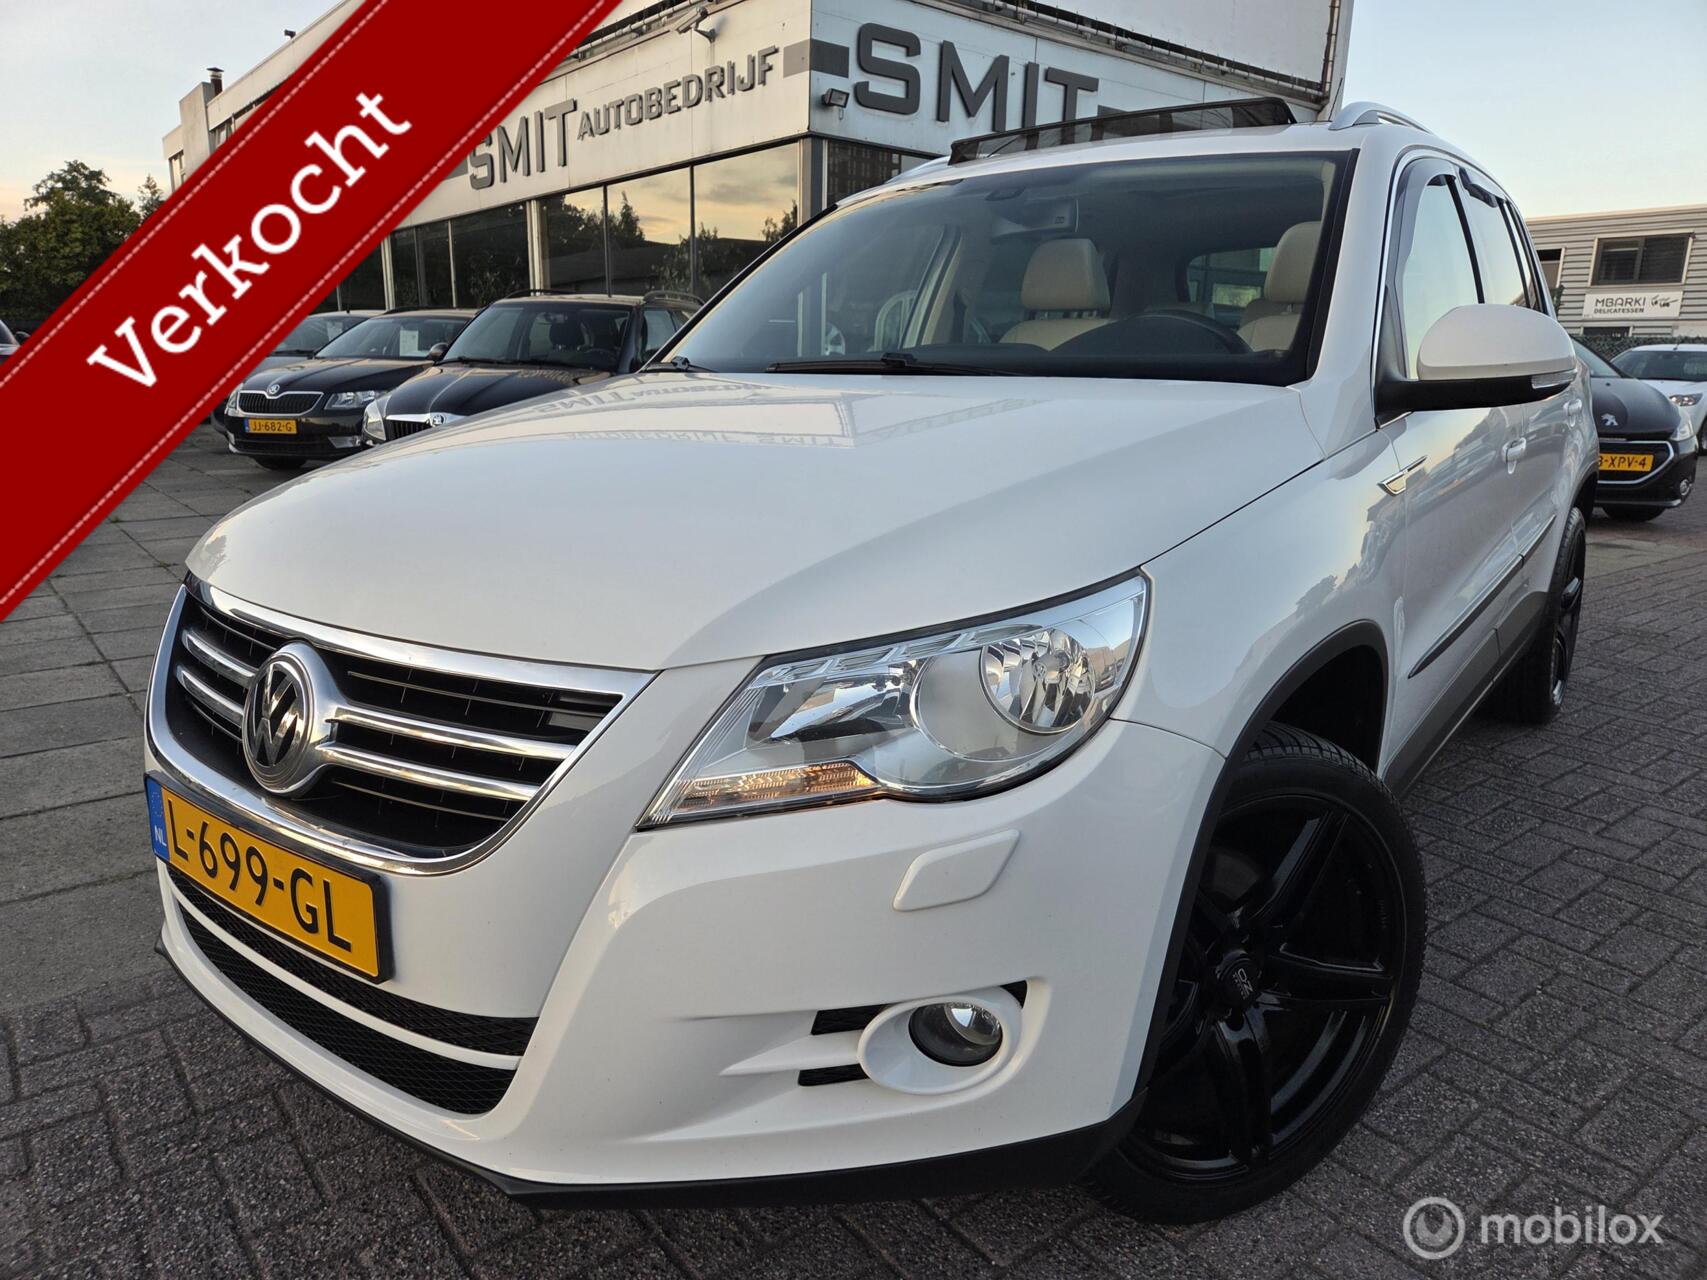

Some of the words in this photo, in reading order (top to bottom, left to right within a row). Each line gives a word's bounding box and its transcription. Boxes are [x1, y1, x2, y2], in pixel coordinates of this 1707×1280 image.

[469, 98, 577, 190] SMIT
[577, 46, 779, 141] AUTOBEDRIJF
[854, 22, 1099, 150] SMIT
[1595, 297, 1646, 307] MBARKI
[155, 825, 167, 846] NL
[167, 798, 352, 952] L-699-GL
